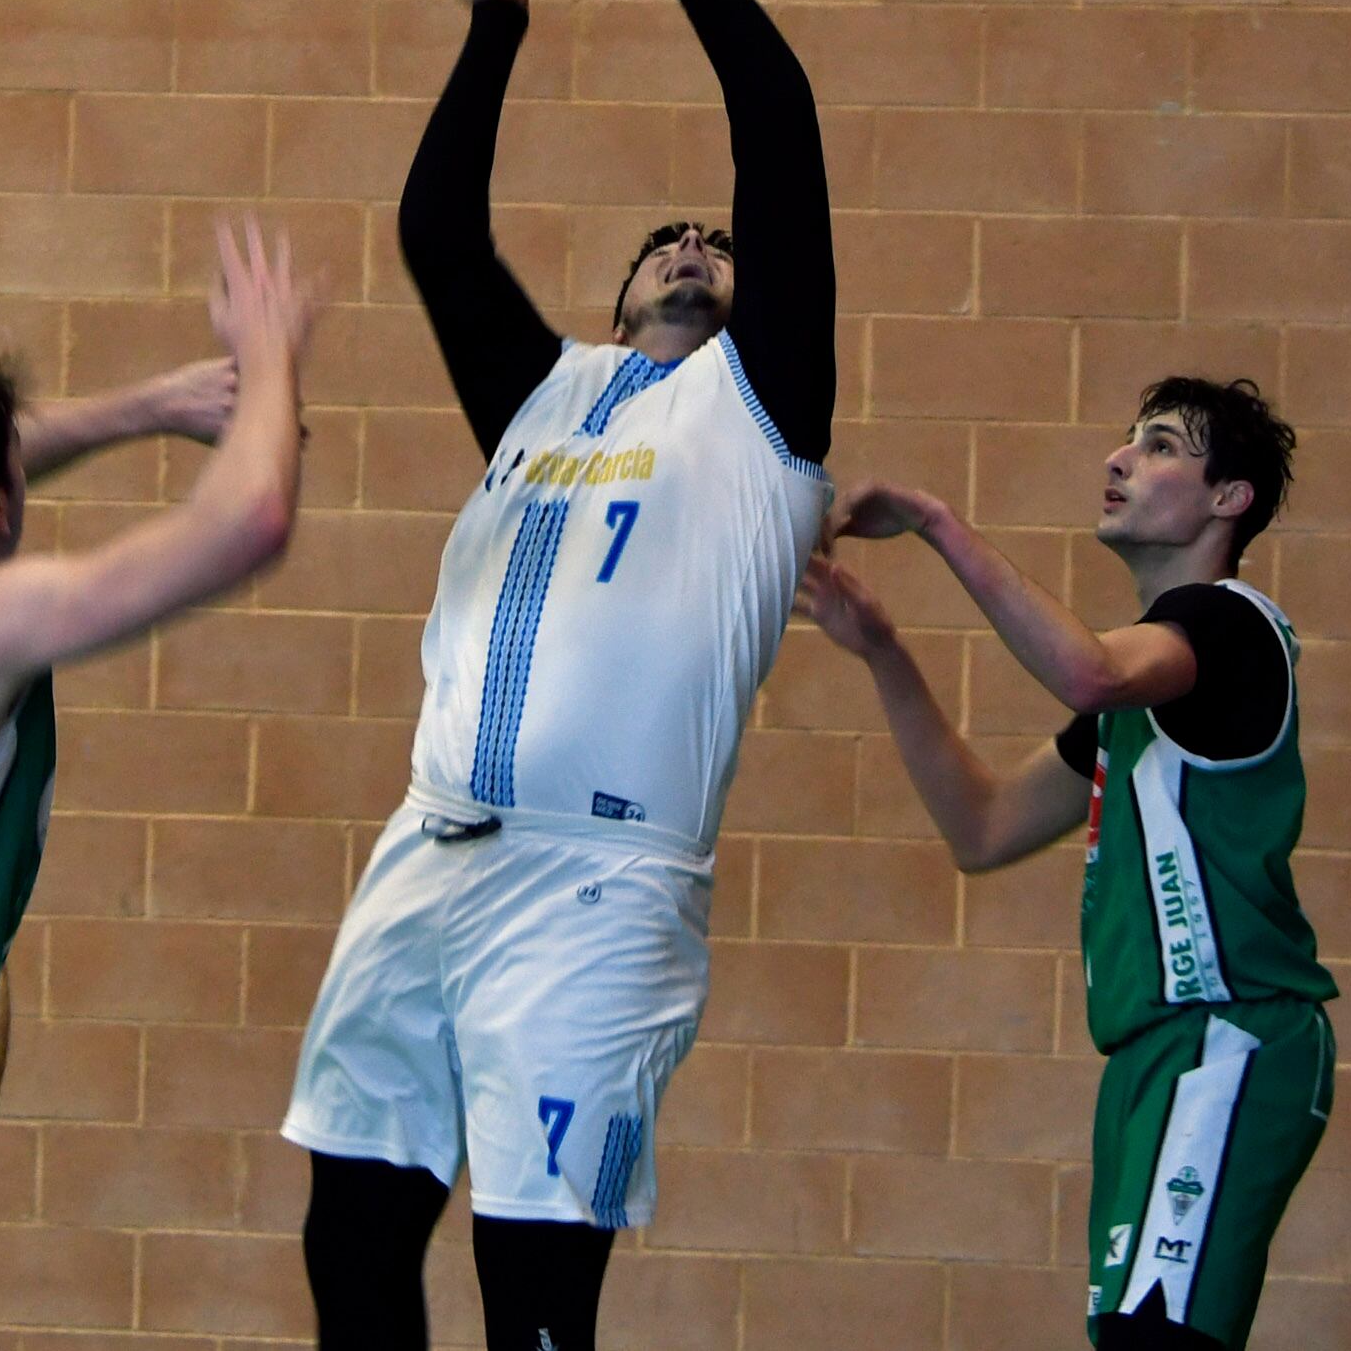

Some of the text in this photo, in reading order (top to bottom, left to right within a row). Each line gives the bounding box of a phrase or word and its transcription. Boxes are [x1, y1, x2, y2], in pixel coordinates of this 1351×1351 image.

[596, 500, 641, 584] 7
[1156, 851, 1202, 1002] RGE JUAN
[538, 1095, 575, 1178] 7
